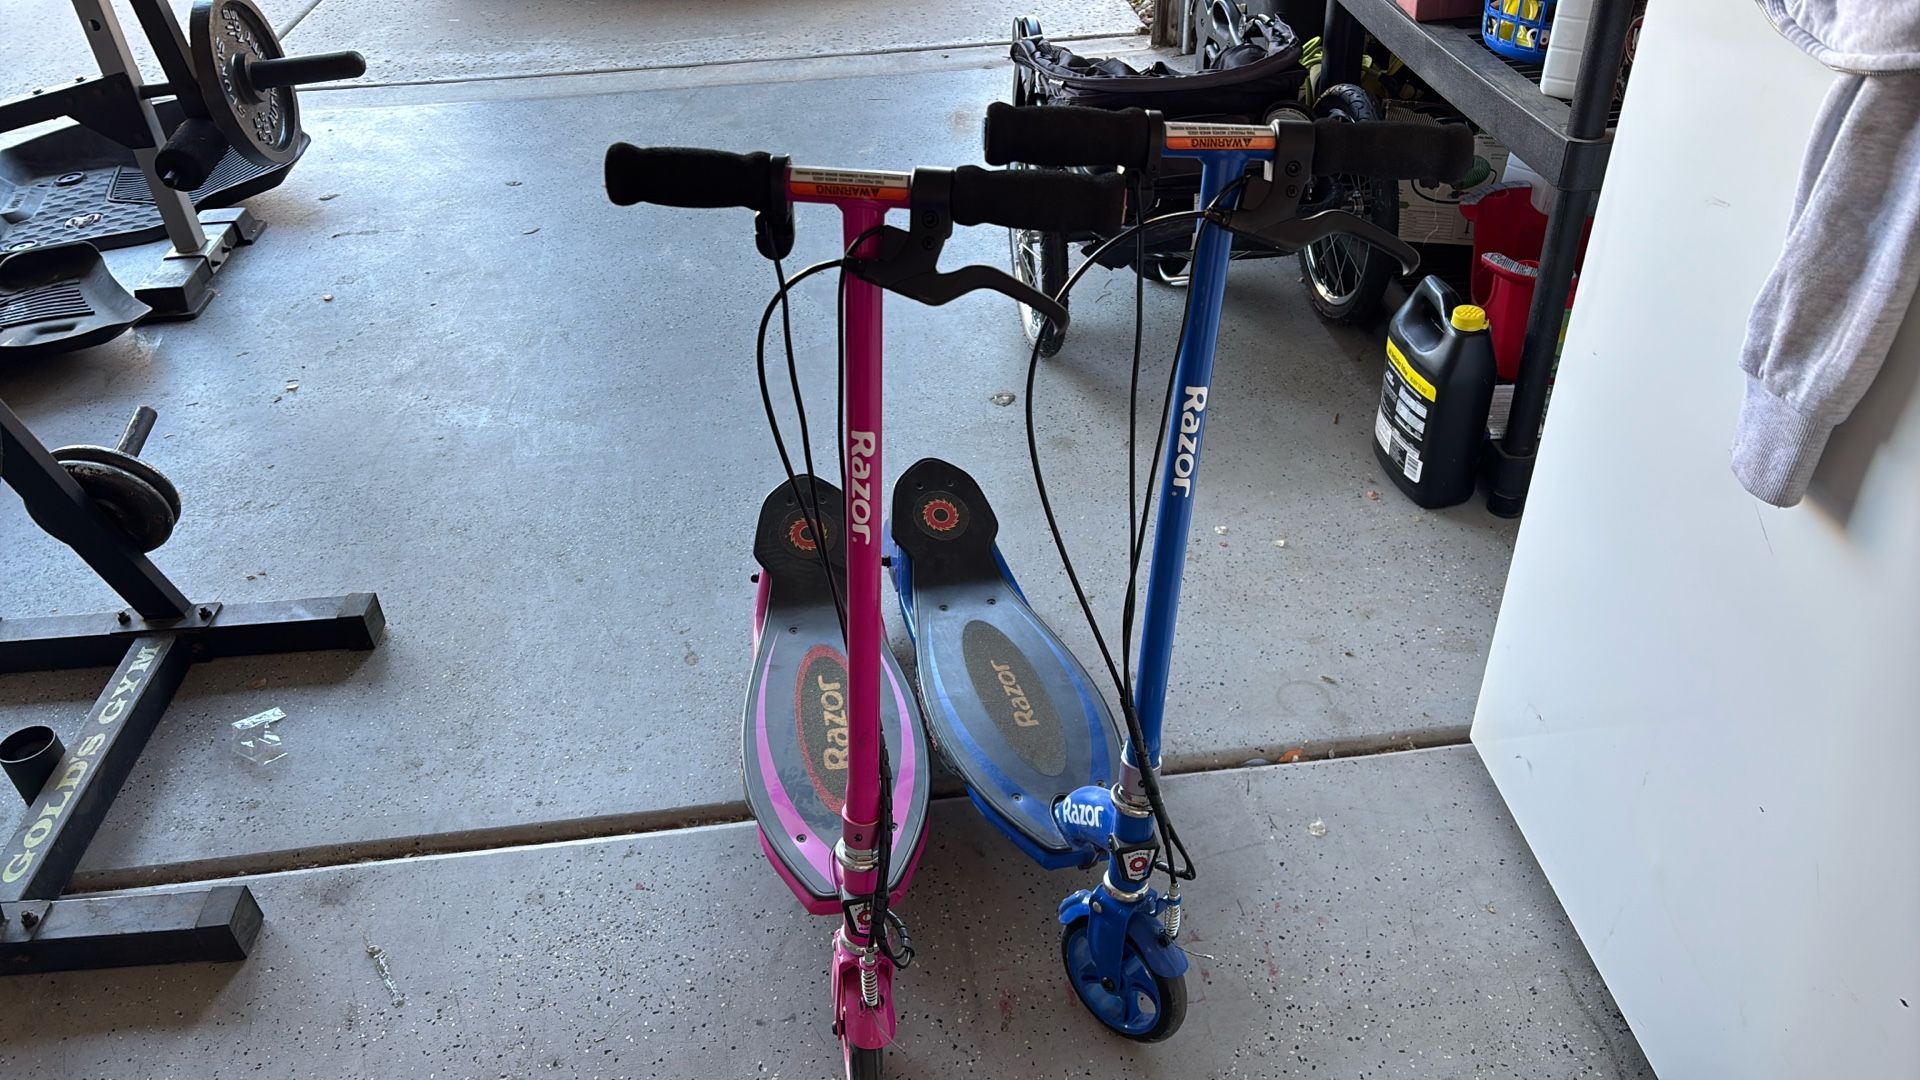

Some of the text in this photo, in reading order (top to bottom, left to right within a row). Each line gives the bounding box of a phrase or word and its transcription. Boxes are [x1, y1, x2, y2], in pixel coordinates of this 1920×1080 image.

[1191, 138, 1242, 148] WARNING
[817, 185, 870, 197] WARNING
[1171, 383, 1209, 498] Razor
[850, 429, 877, 546] Razor
[823, 675, 850, 772] Razor
[989, 660, 1041, 730] Razor
[2, 643, 163, 883] GOLD'S GYM
[1062, 796, 1105, 828] Razor
